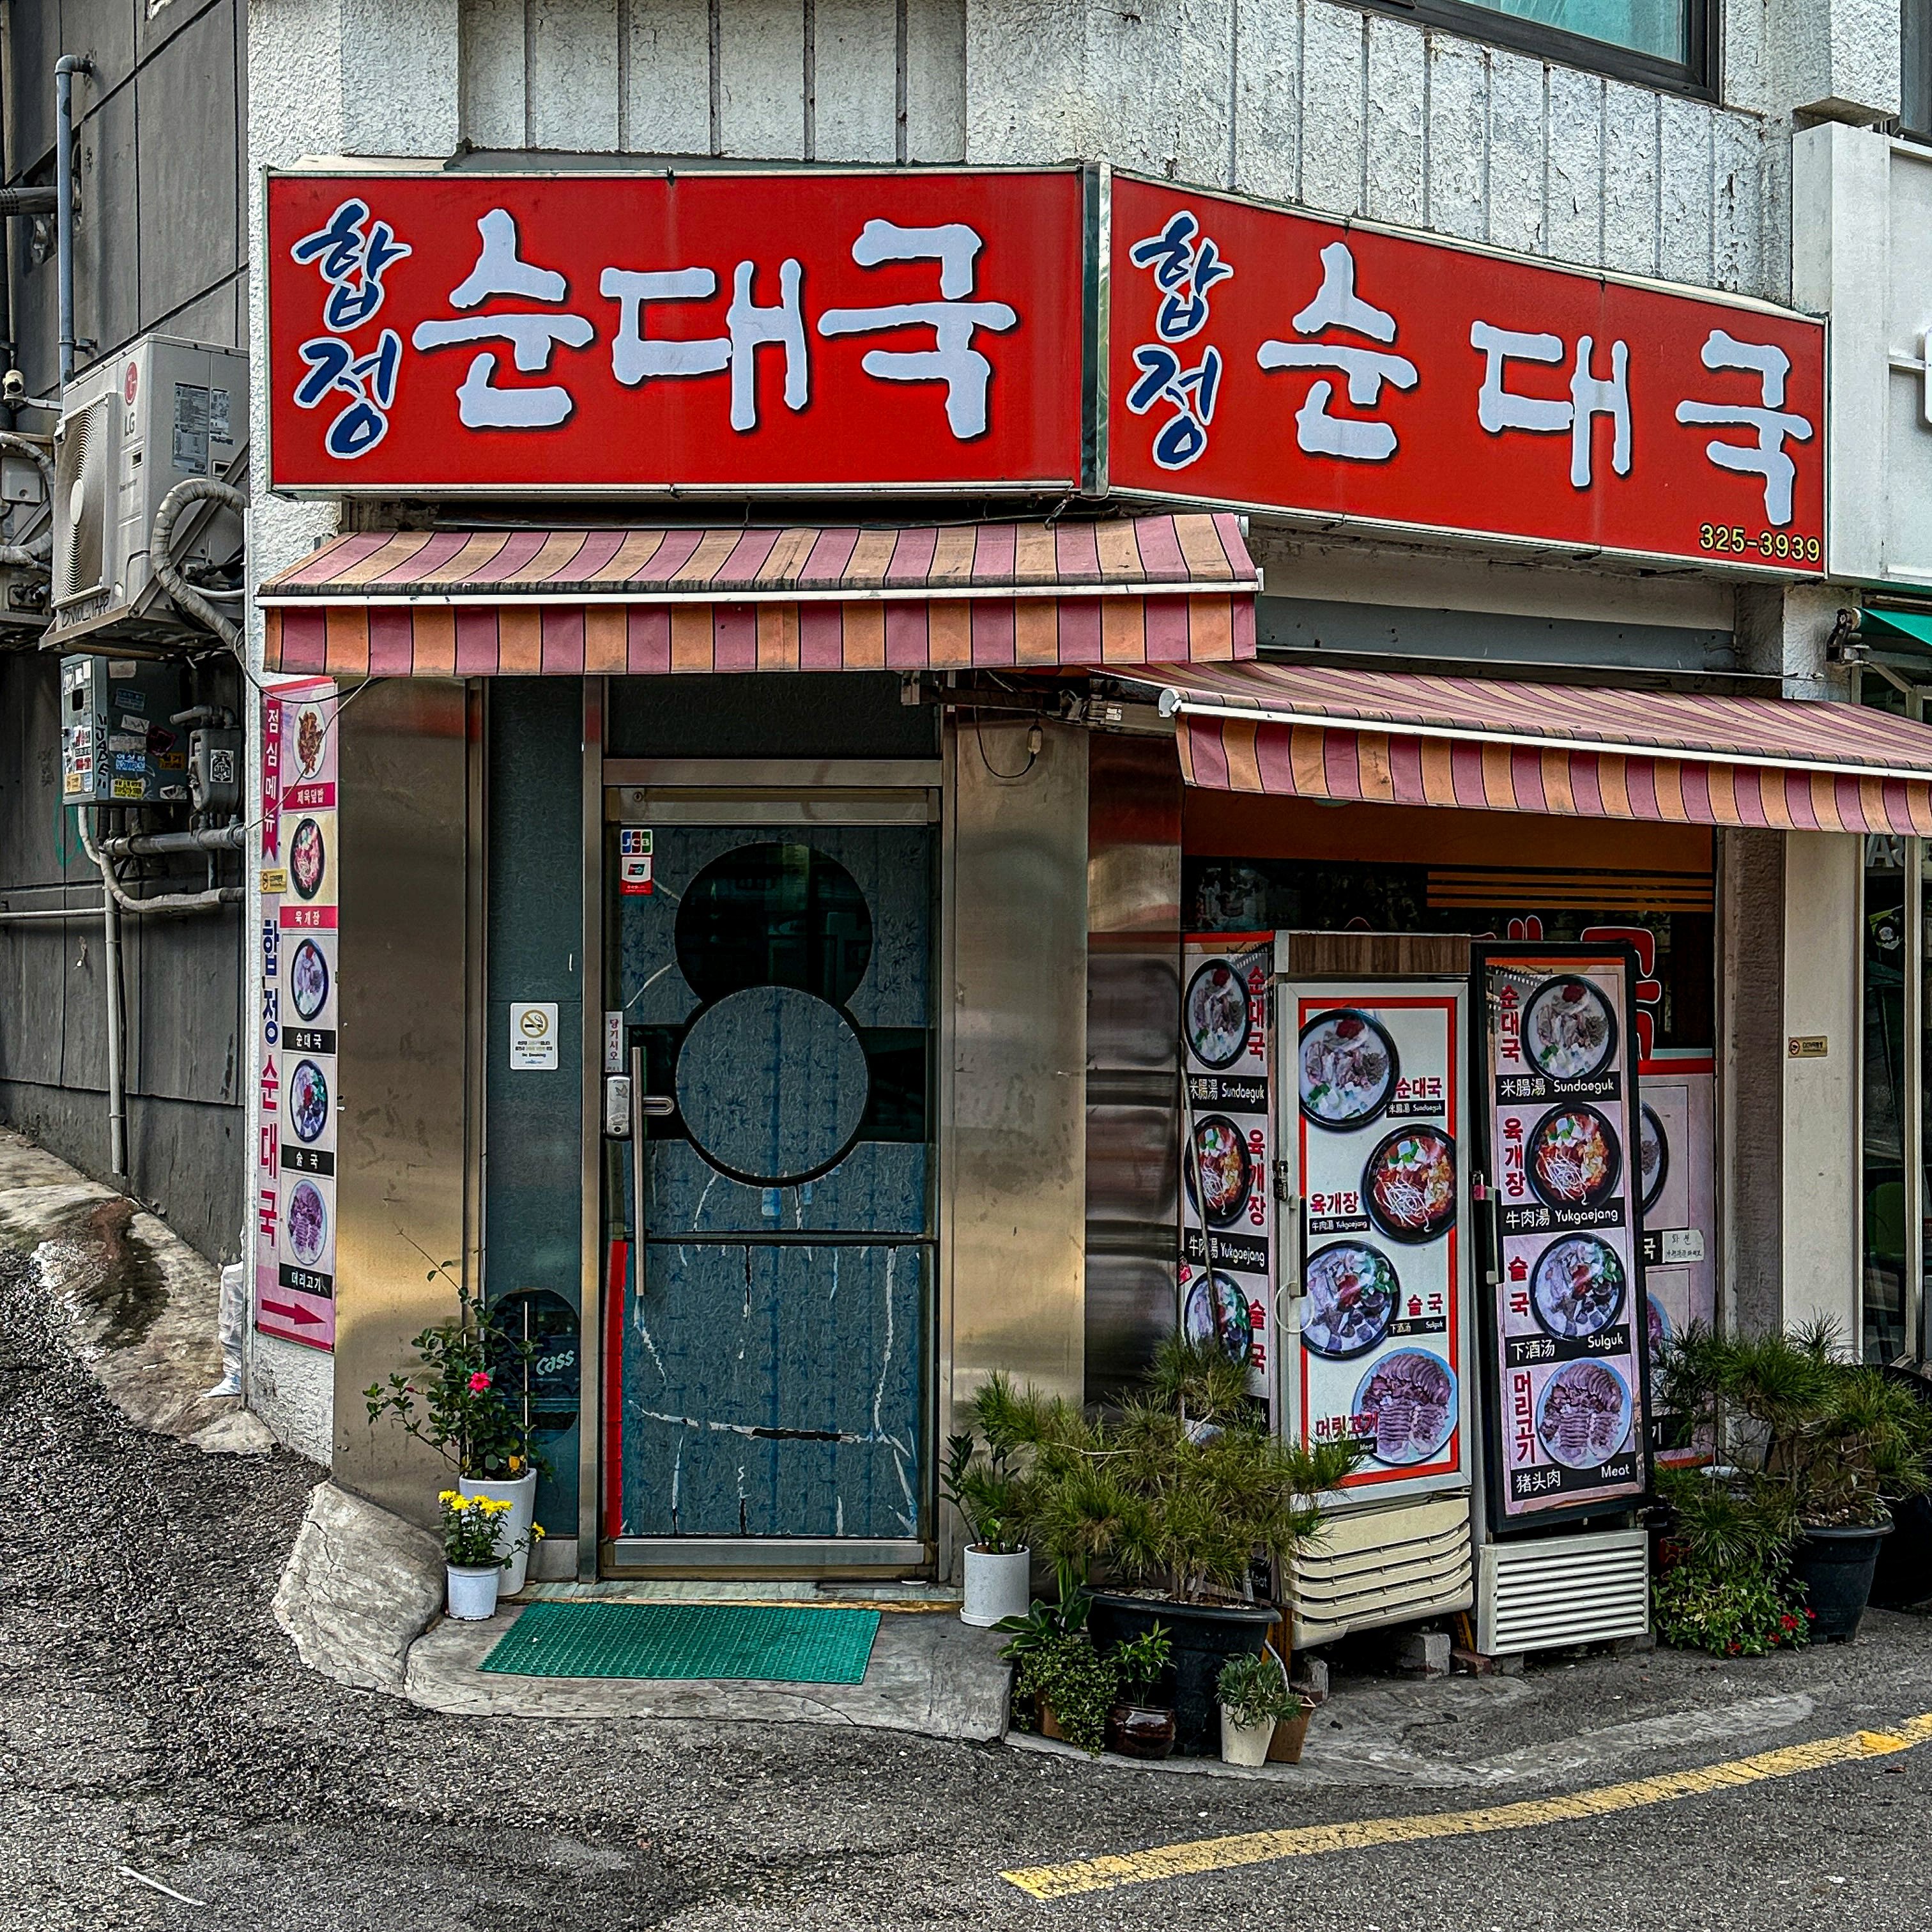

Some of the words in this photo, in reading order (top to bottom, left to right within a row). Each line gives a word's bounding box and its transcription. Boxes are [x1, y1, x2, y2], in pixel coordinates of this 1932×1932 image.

[291, 198, 412, 459] 합정
[413, 208, 1017, 439] 순대국
[1127, 210, 1233, 470] 합정
[1257, 242, 1813, 525] 순대국
[124, 411, 135, 437] LG
[1700, 523, 1821, 563] 325-3939
[264, 709, 278, 833] 점심메뉴
[263, 919, 280, 1046] 합정
[1247, 965, 1266, 1061] 순대국
[610, 1019, 619, 1060] 당기시오
[1499, 985, 1521, 1063] 순대국
[1222, 1082, 1264, 1104] Sundaeguk
[1395, 1077, 1442, 1099] 순대국
[1554, 1078, 1614, 1094] Sundaeguk
[259, 1055, 279, 1248] 순대국
[1247, 1129, 1266, 1226] 육개장
[1503, 1117, 1526, 1197] 육개장
[1310, 1191, 1359, 1215] 육개장
[1506, 1208, 1551, 1229] 牛肉湯
[1555, 1208, 1618, 1225] Yukgaejang
[1407, 1292, 1443, 1316] 술국
[1508, 1256, 1529, 1317] 술국
[1248, 1298, 1266, 1375] 술국
[1588, 1332, 1624, 1349] Sulguk
[1514, 1370, 1536, 1464] 머리고기
[1516, 1468, 1561, 1494] 猪头肉
[1601, 1464, 1630, 1478] Meat
